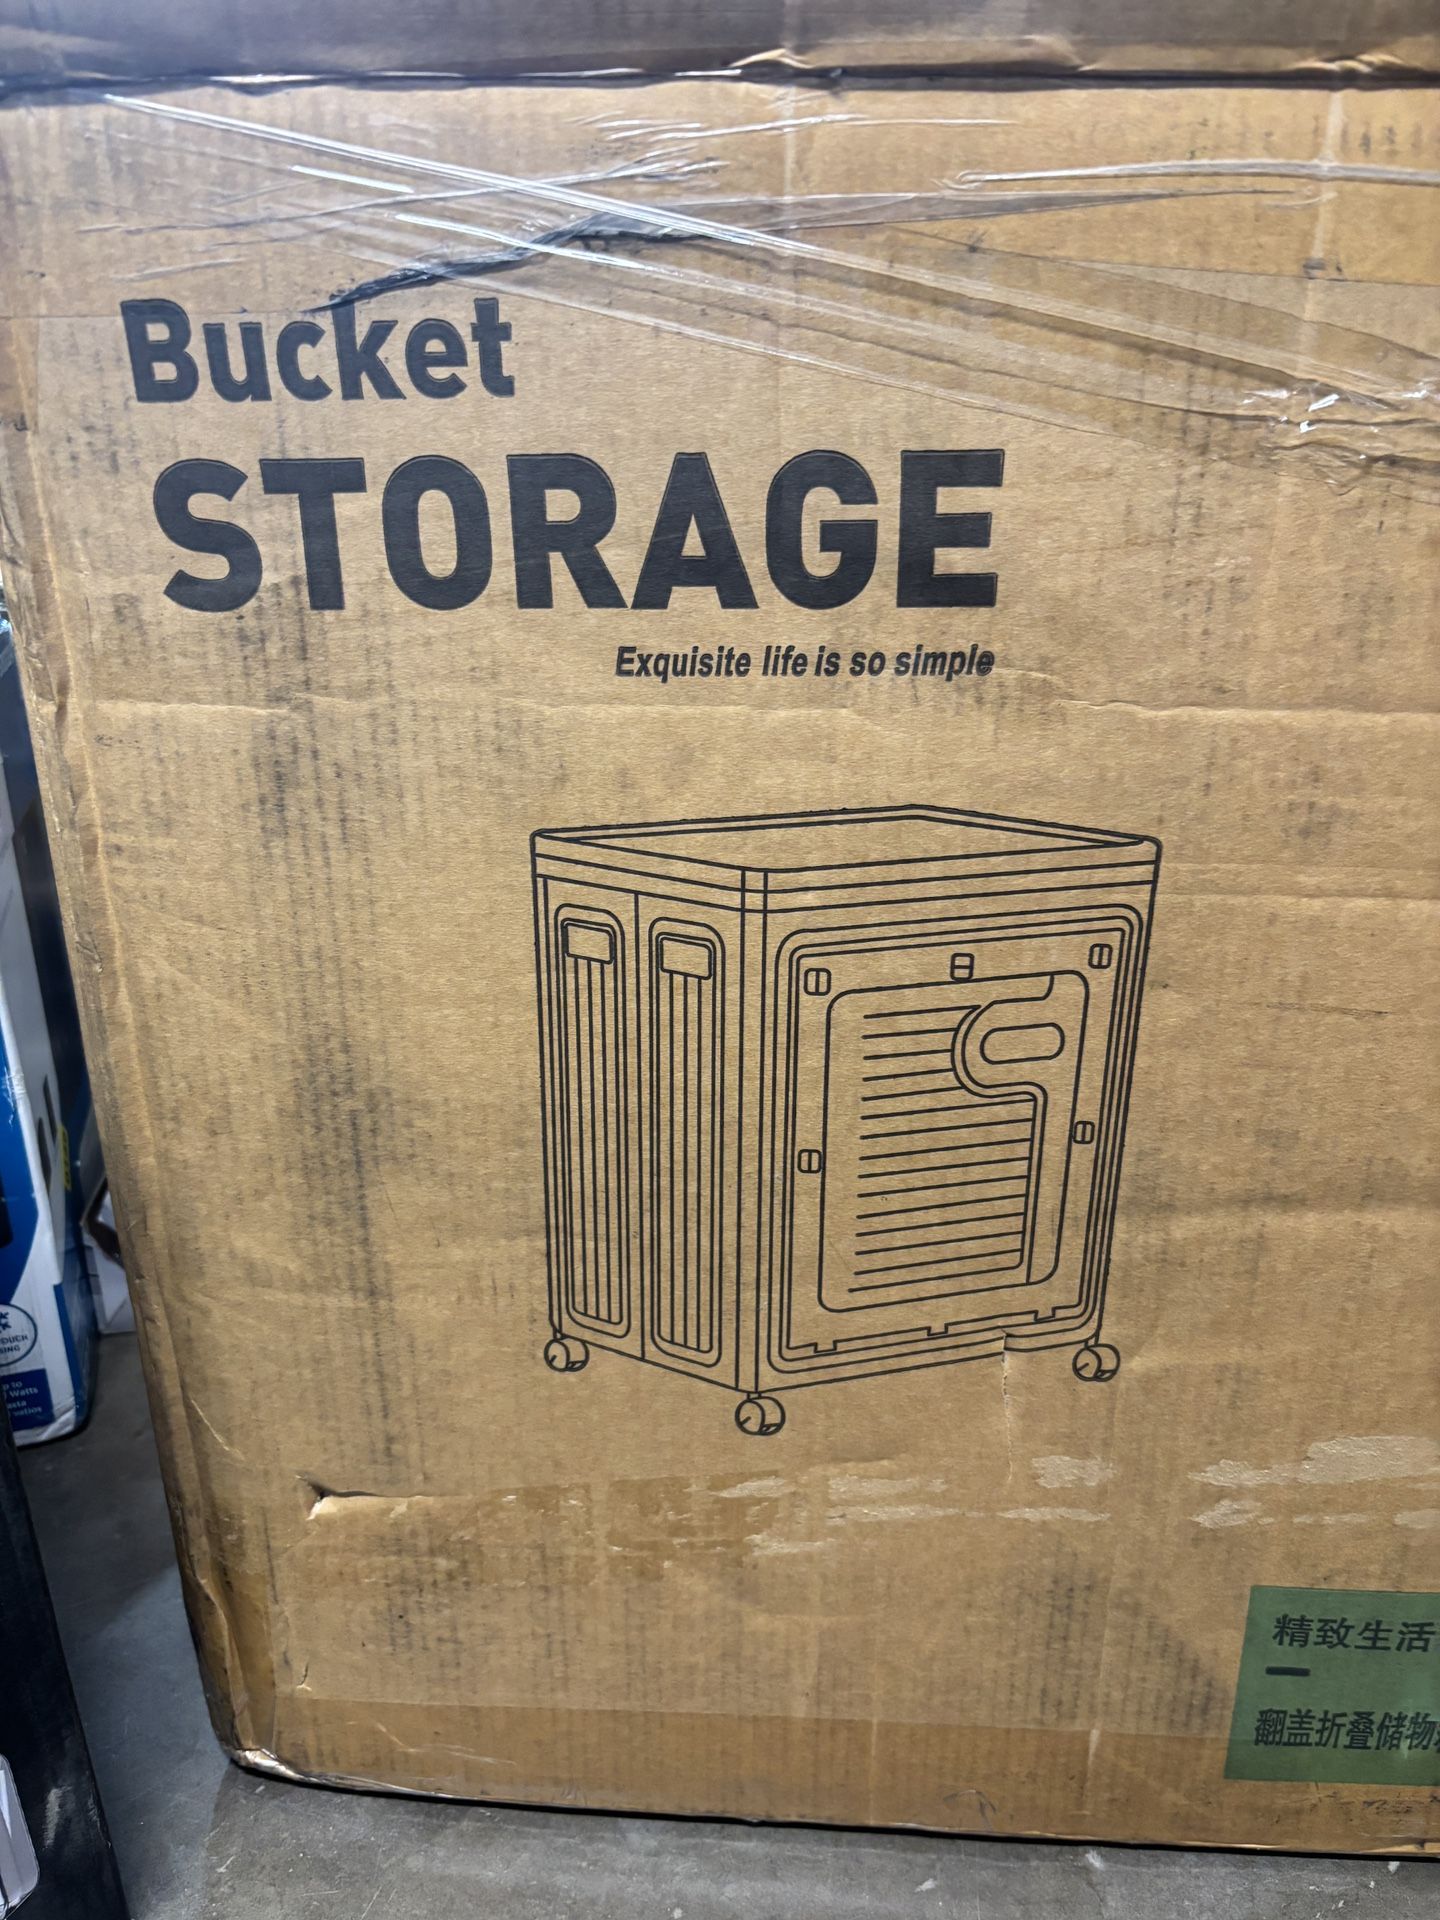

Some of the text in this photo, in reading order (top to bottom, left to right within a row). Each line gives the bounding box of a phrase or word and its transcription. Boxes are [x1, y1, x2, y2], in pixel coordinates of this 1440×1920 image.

[120, 293, 515, 403] Bucket
[153, 448, 1005, 613] STORAGE
[615, 643, 996, 684] Exquisite life is so simple
[1272, 1613, 1436, 1653] 精致生活
[1254, 1708, 1440, 1753] 翻盖折叠储物
